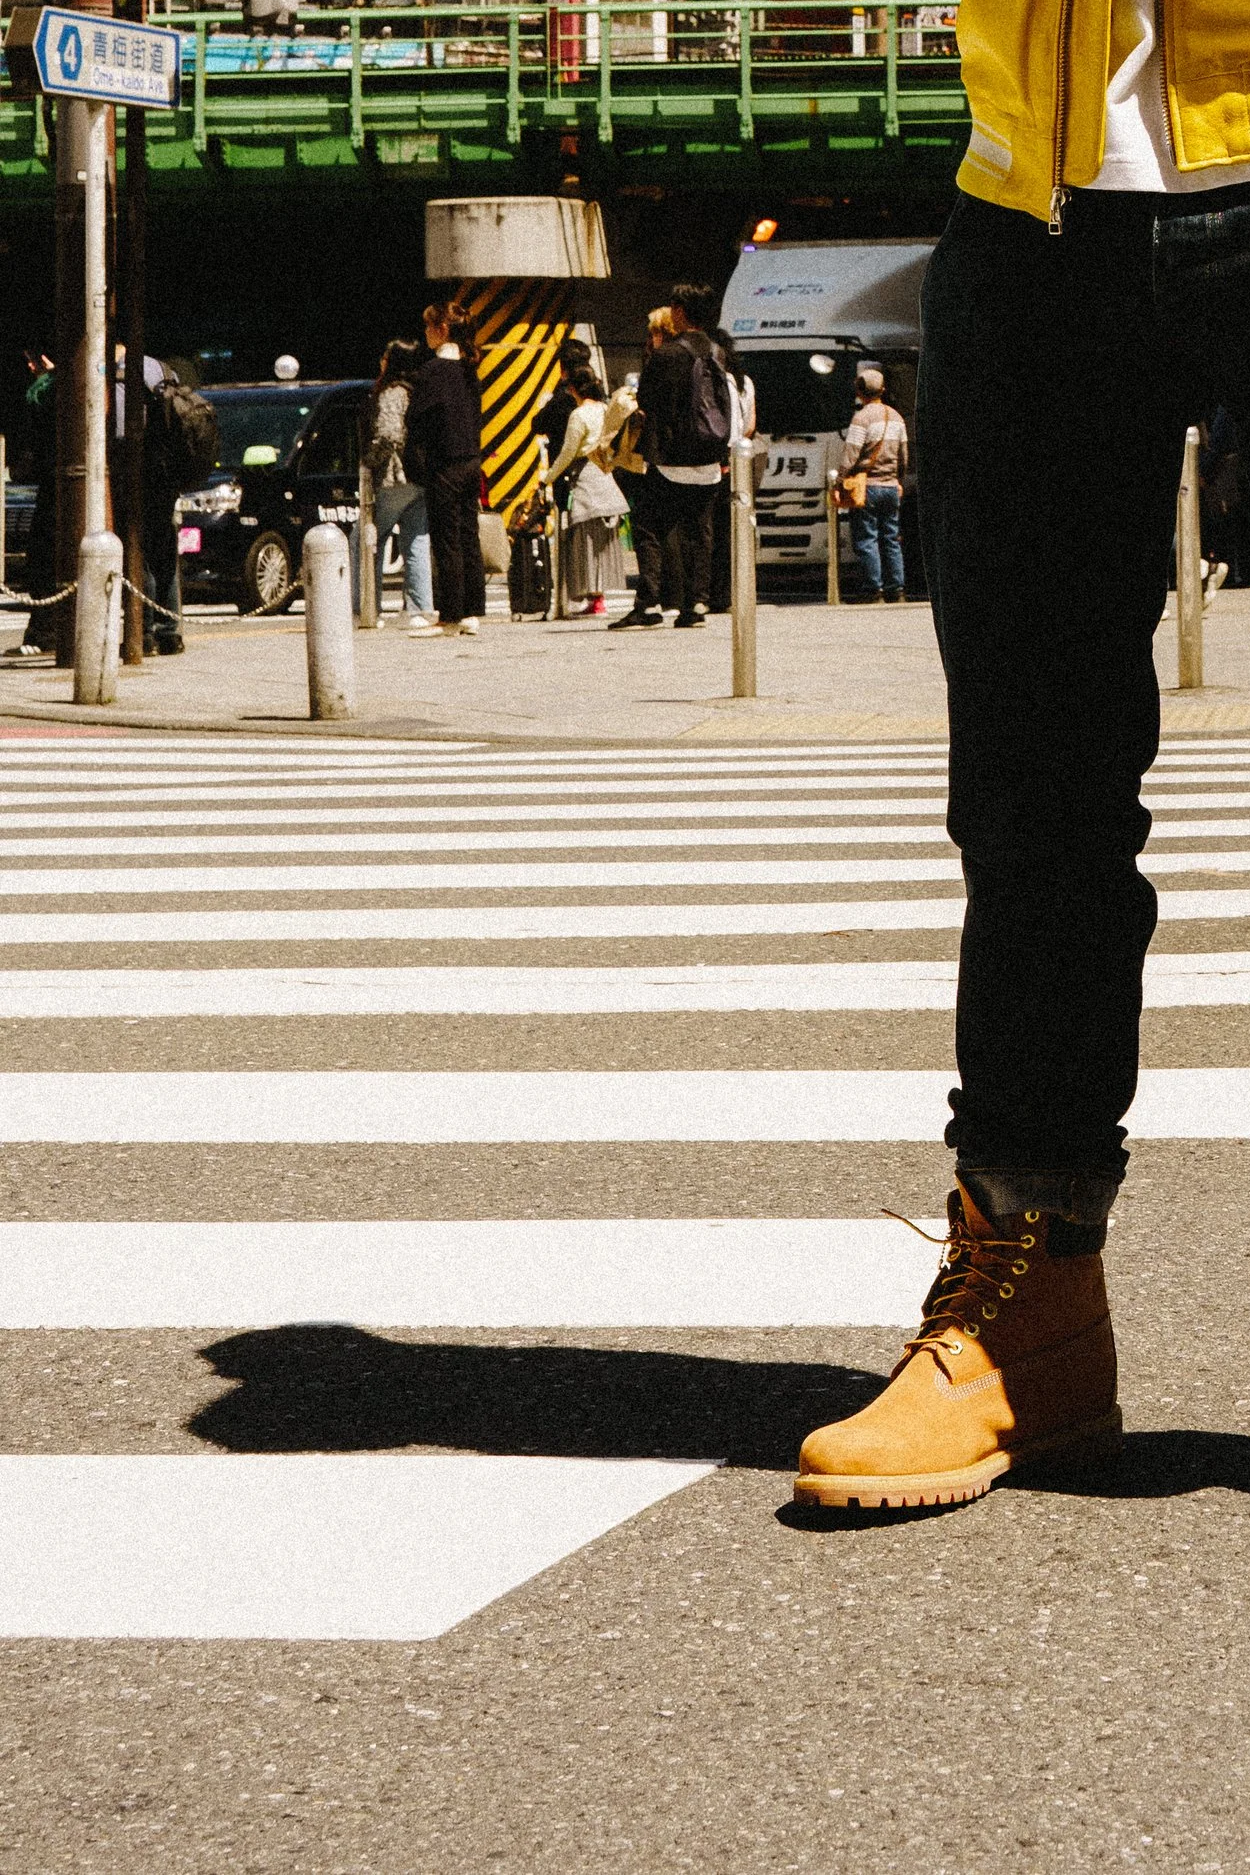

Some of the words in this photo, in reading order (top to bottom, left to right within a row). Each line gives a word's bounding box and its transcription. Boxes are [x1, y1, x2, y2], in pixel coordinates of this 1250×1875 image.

[63, 33, 77, 73] 4
[93, 30, 166, 75] 青梅街道
